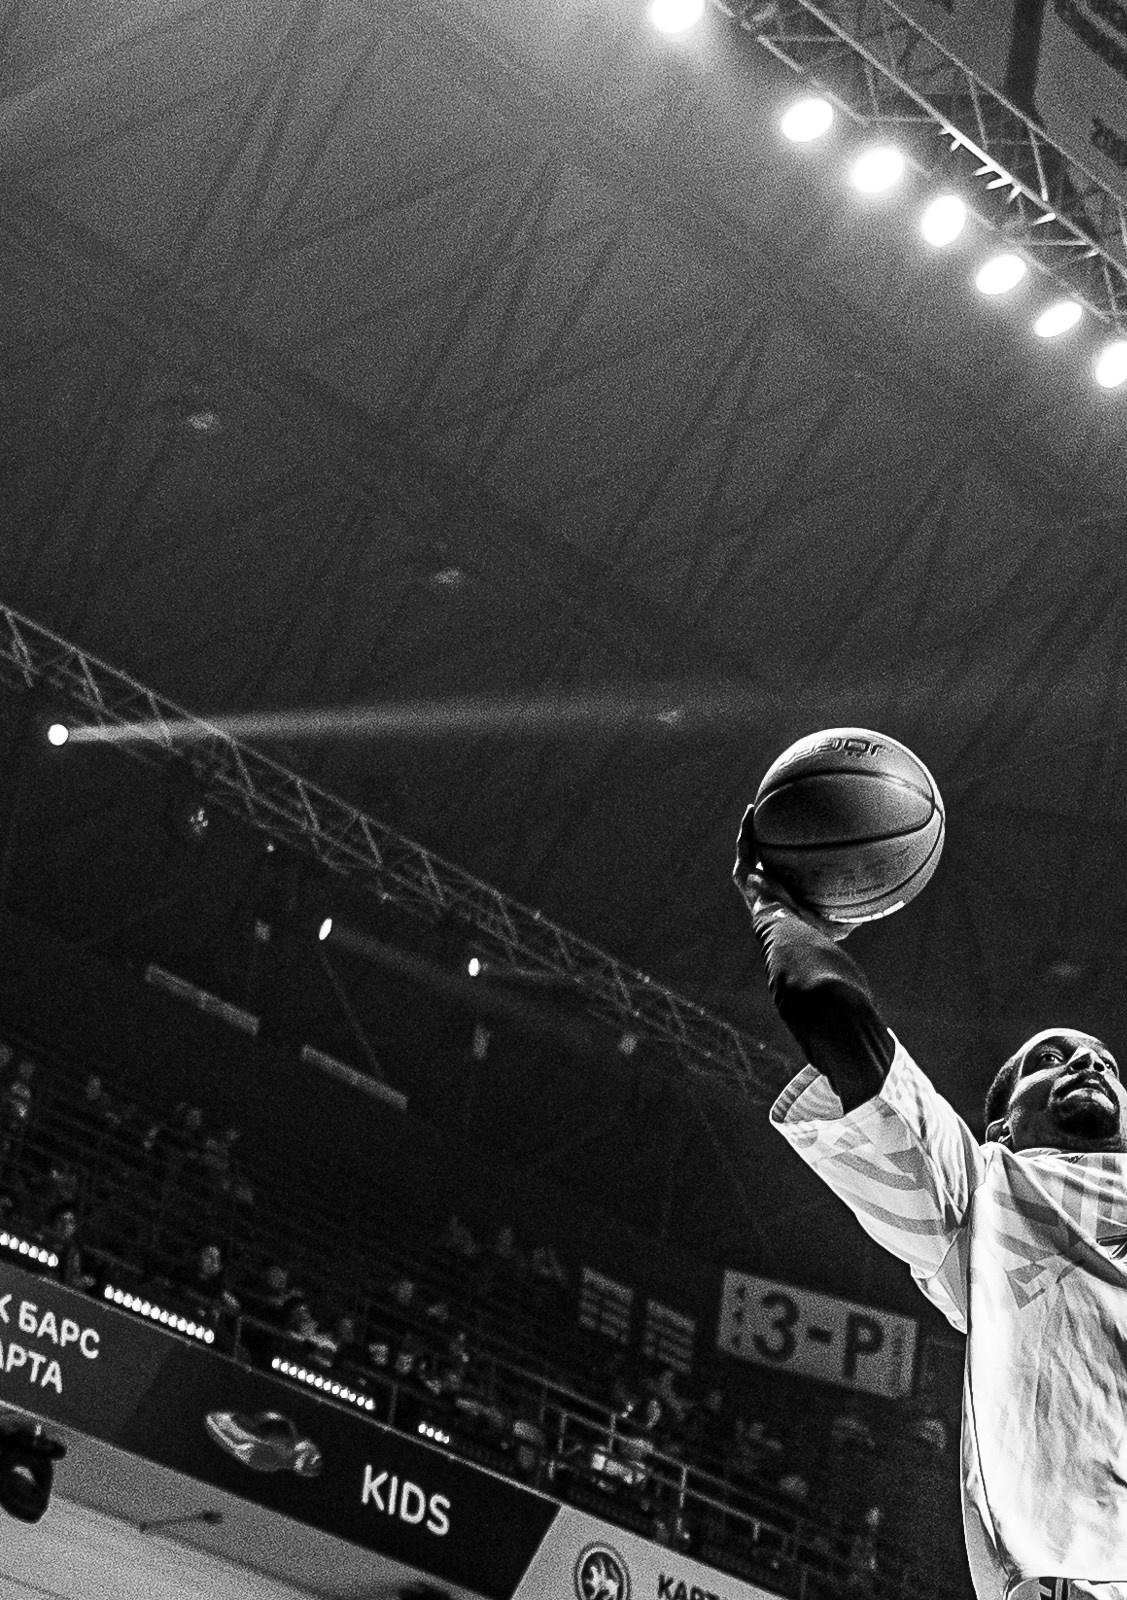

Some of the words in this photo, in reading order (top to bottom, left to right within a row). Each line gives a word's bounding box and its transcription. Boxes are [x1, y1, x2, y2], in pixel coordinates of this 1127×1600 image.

[19, 1300, 100, 1359] БАРС
[0, 1341, 62, 1394] РТА
[362, 1465, 451, 1536] KIDS
